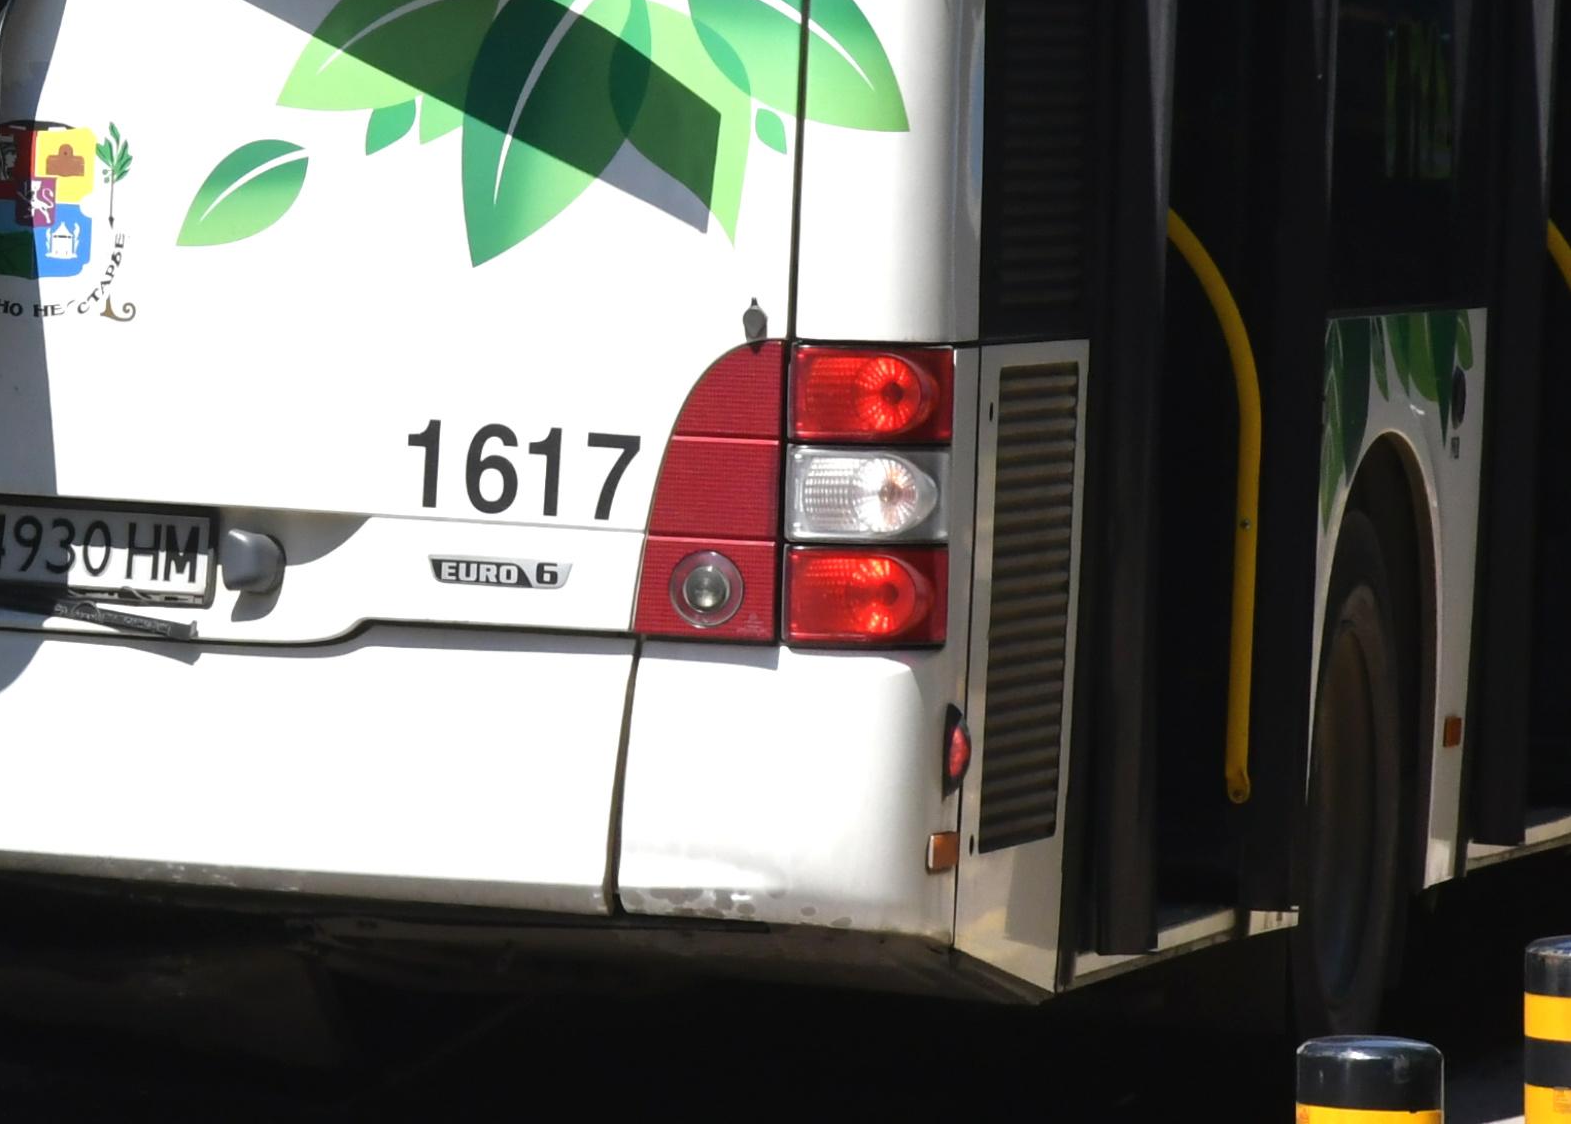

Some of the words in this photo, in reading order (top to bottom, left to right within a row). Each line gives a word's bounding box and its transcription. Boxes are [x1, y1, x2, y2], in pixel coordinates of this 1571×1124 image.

[33, 301, 65, 318] НЕ
[407, 418, 642, 521] 1617
[125, 522, 201, 584] HM
[440, 561, 519, 585] EURO
[535, 562, 560, 585] 6
